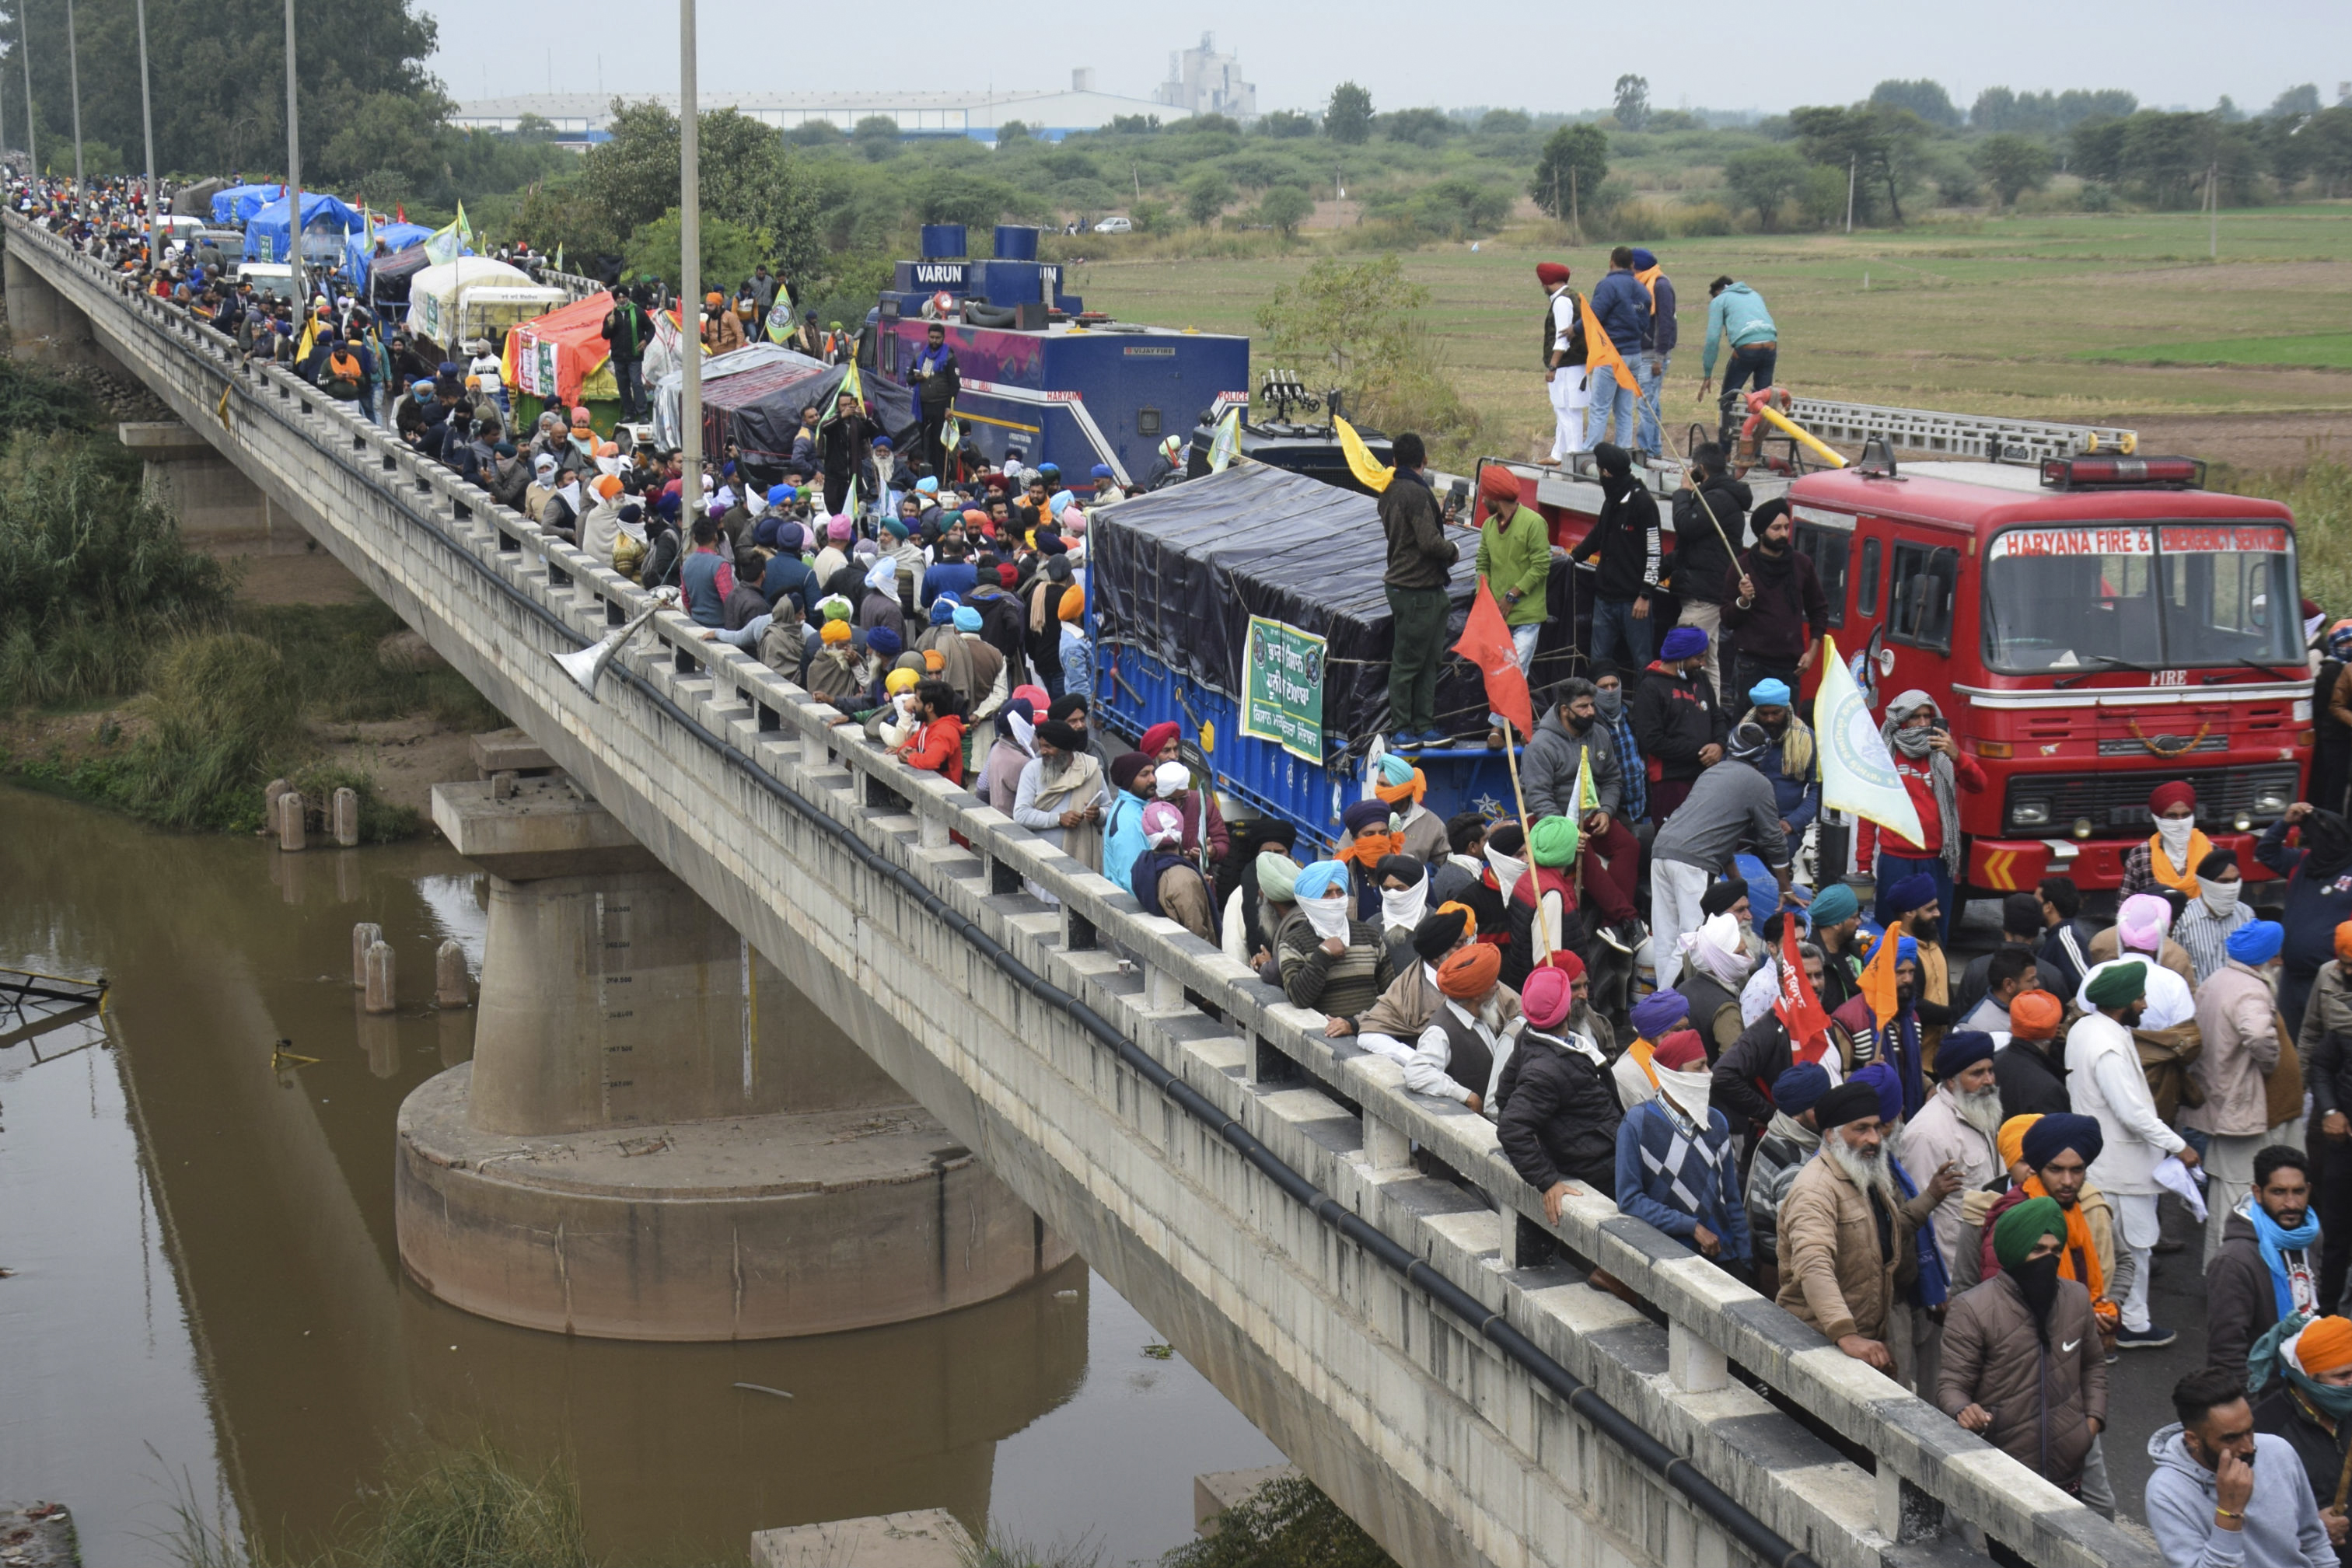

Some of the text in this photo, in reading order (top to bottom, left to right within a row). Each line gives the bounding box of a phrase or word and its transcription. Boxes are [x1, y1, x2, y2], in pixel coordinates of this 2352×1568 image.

[917, 265, 962, 282] VARUN
[1047, 391, 1249, 402] HARYANA POLICE
[1646, 525, 1662, 554] TOMMY
[2005, 528, 2287, 557] HARYANA FIRE & EMERGENCY SERVICES
[2149, 669, 2187, 686] FIRE
